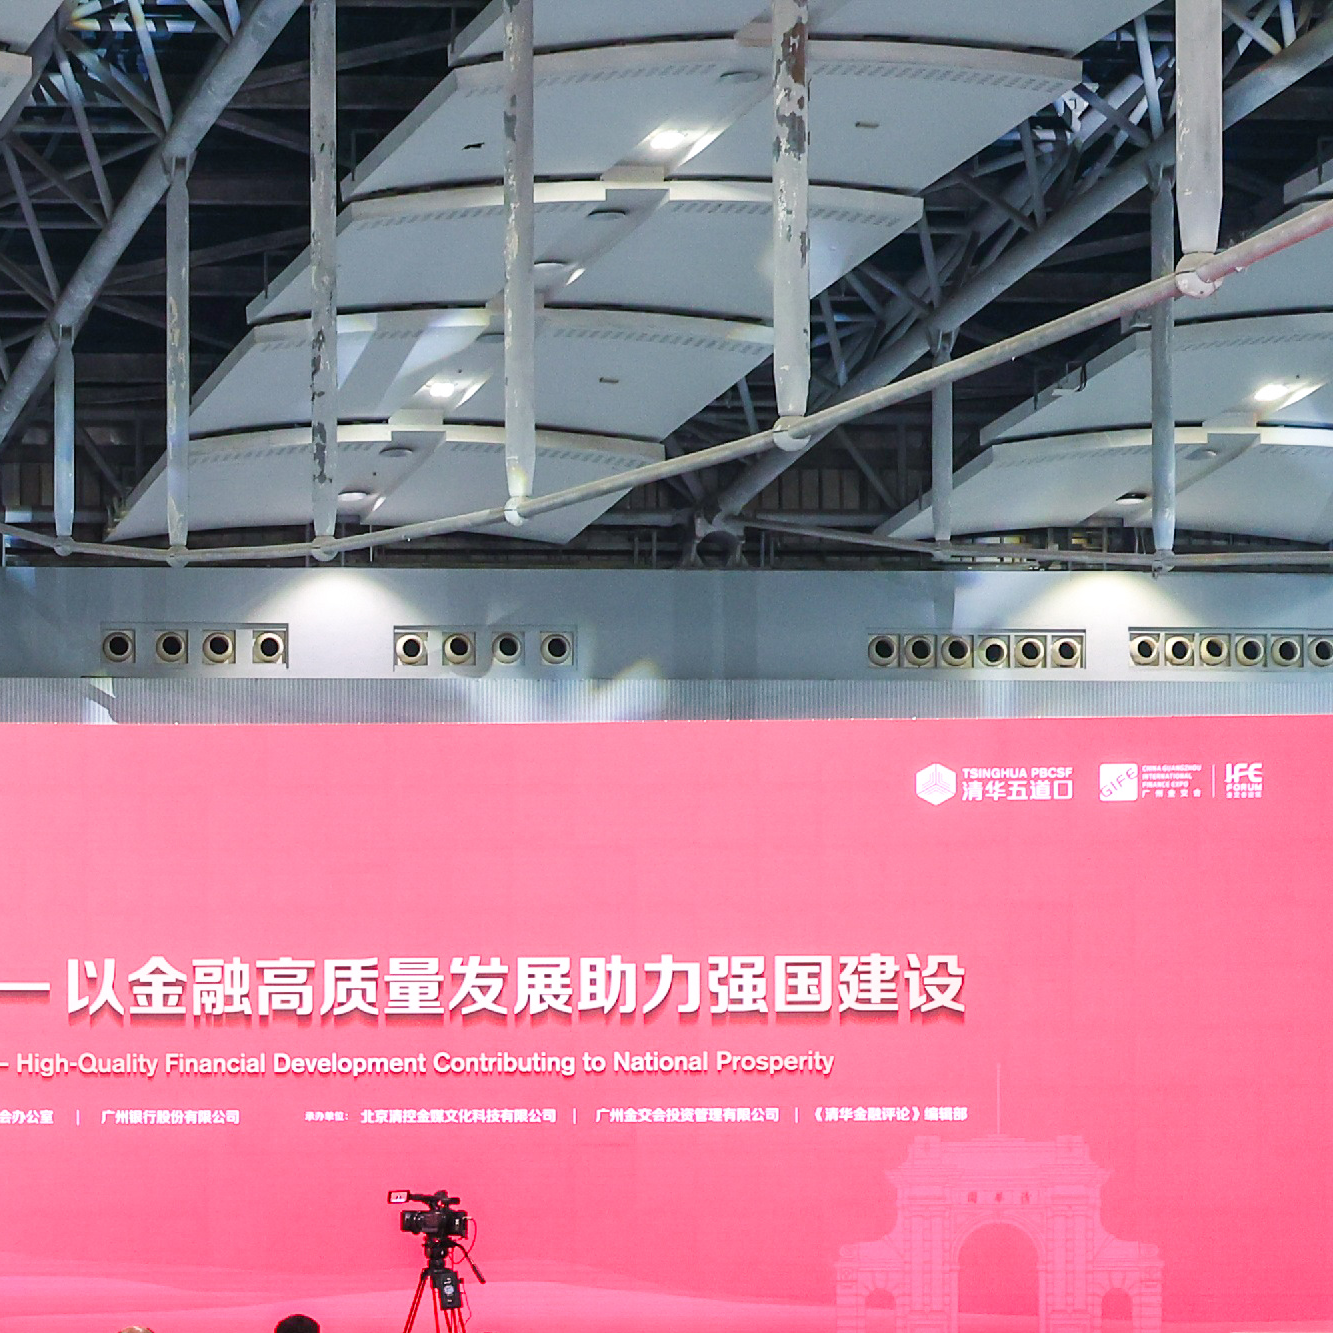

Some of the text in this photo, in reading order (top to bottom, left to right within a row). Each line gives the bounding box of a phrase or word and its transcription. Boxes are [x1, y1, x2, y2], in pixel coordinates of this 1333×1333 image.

[962, 766, 1073, 779] TSINGHUA PBCSF
[962, 780, 1073, 801] 清华五道口
[17, 1052, 159, 1077] High-Quality
[165, 1052, 266, 1073] Financial
[273, 1052, 427, 1077] Development
[433, 1051, 575, 1076] Contributing
[581, 1052, 606, 1072] to
[613, 1051, 708, 1072] National
[716, 1050, 835, 1075] Prosperity
[101, 1109, 240, 1125] 广州银行股份有限公司
[595, 1107, 779, 1123] 广州金交会投资管理有限公司
